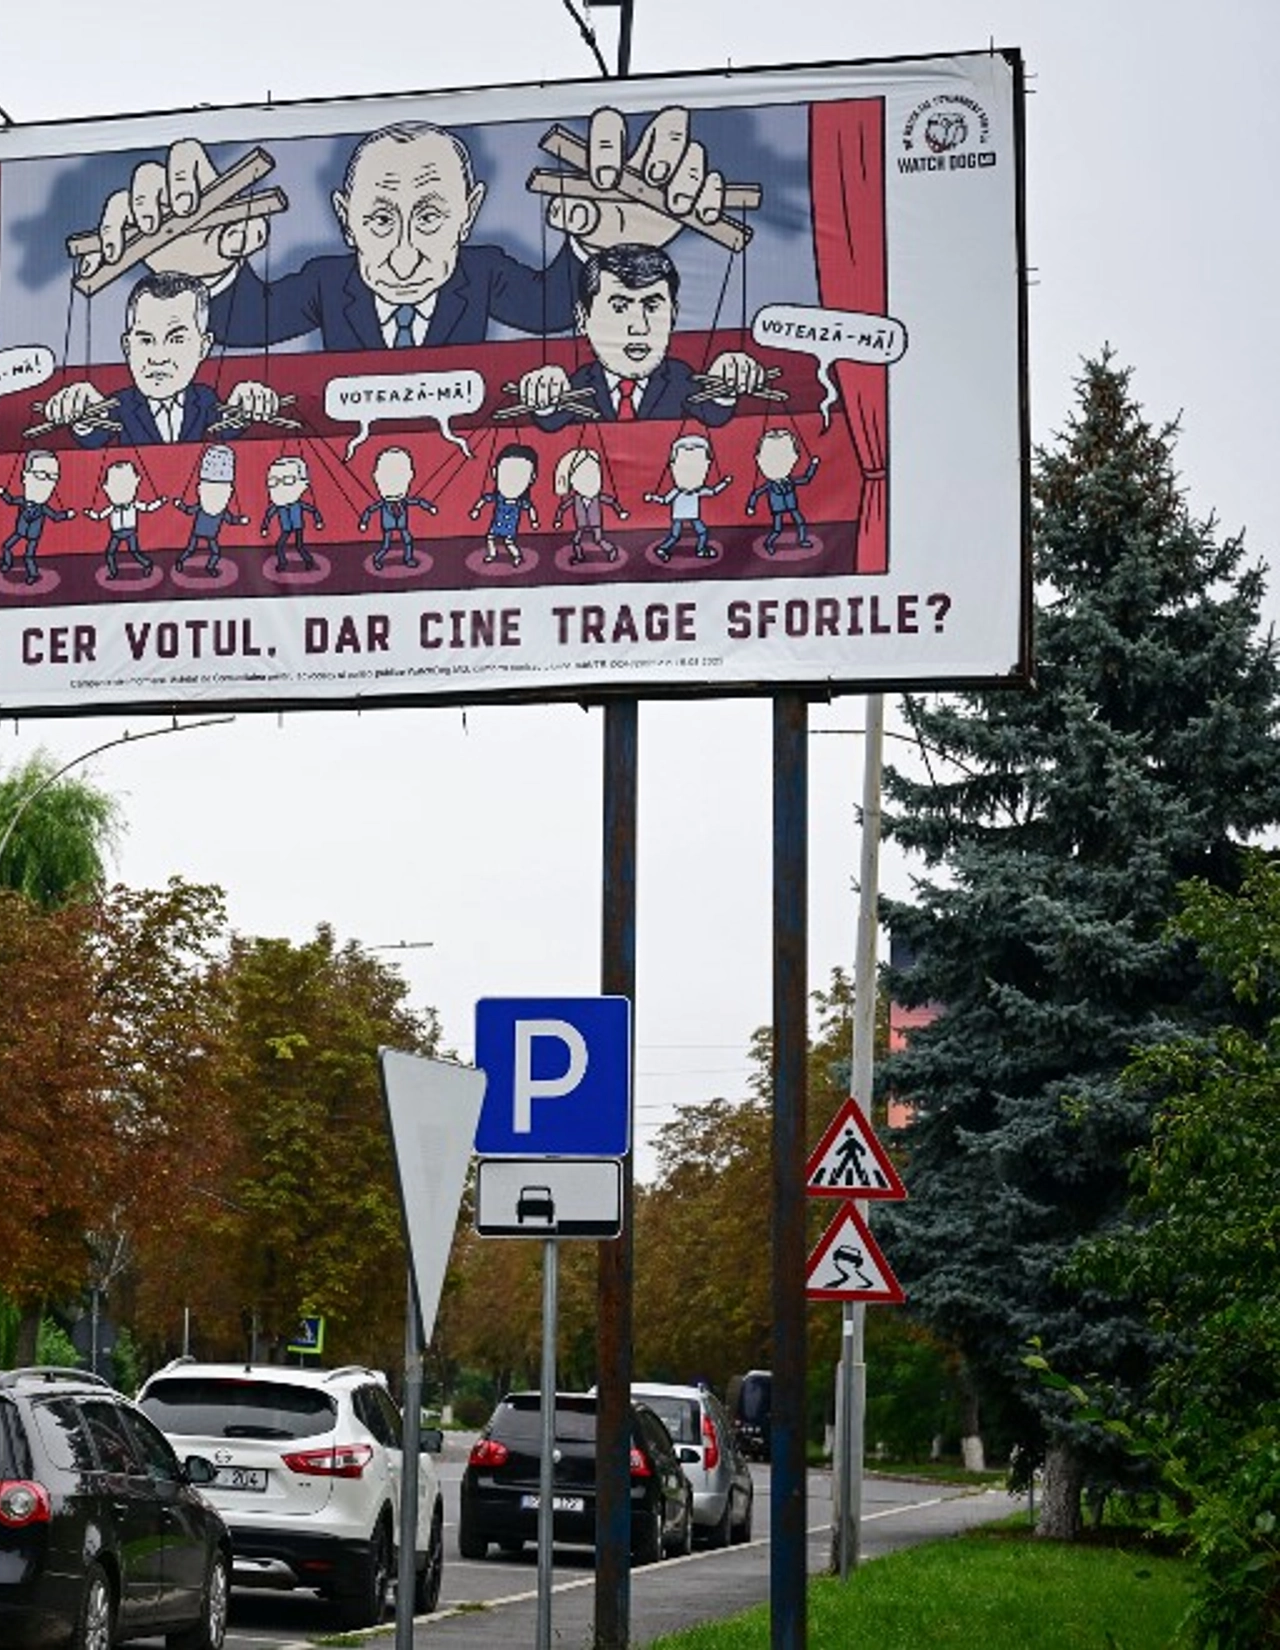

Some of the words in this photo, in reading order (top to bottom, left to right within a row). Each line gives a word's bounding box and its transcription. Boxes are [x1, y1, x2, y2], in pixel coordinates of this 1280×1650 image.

[898, 156, 945, 173] WATCH
[949, 152, 976, 170] DOG
[21, 624, 97, 665] CER
[304, 614, 391, 653] DAR
[419, 607, 522, 649] CINE
[552, 602, 697, 645] TRAGE
[726, 593, 952, 640] SFORILE?
[513, 1018, 589, 1134] P
